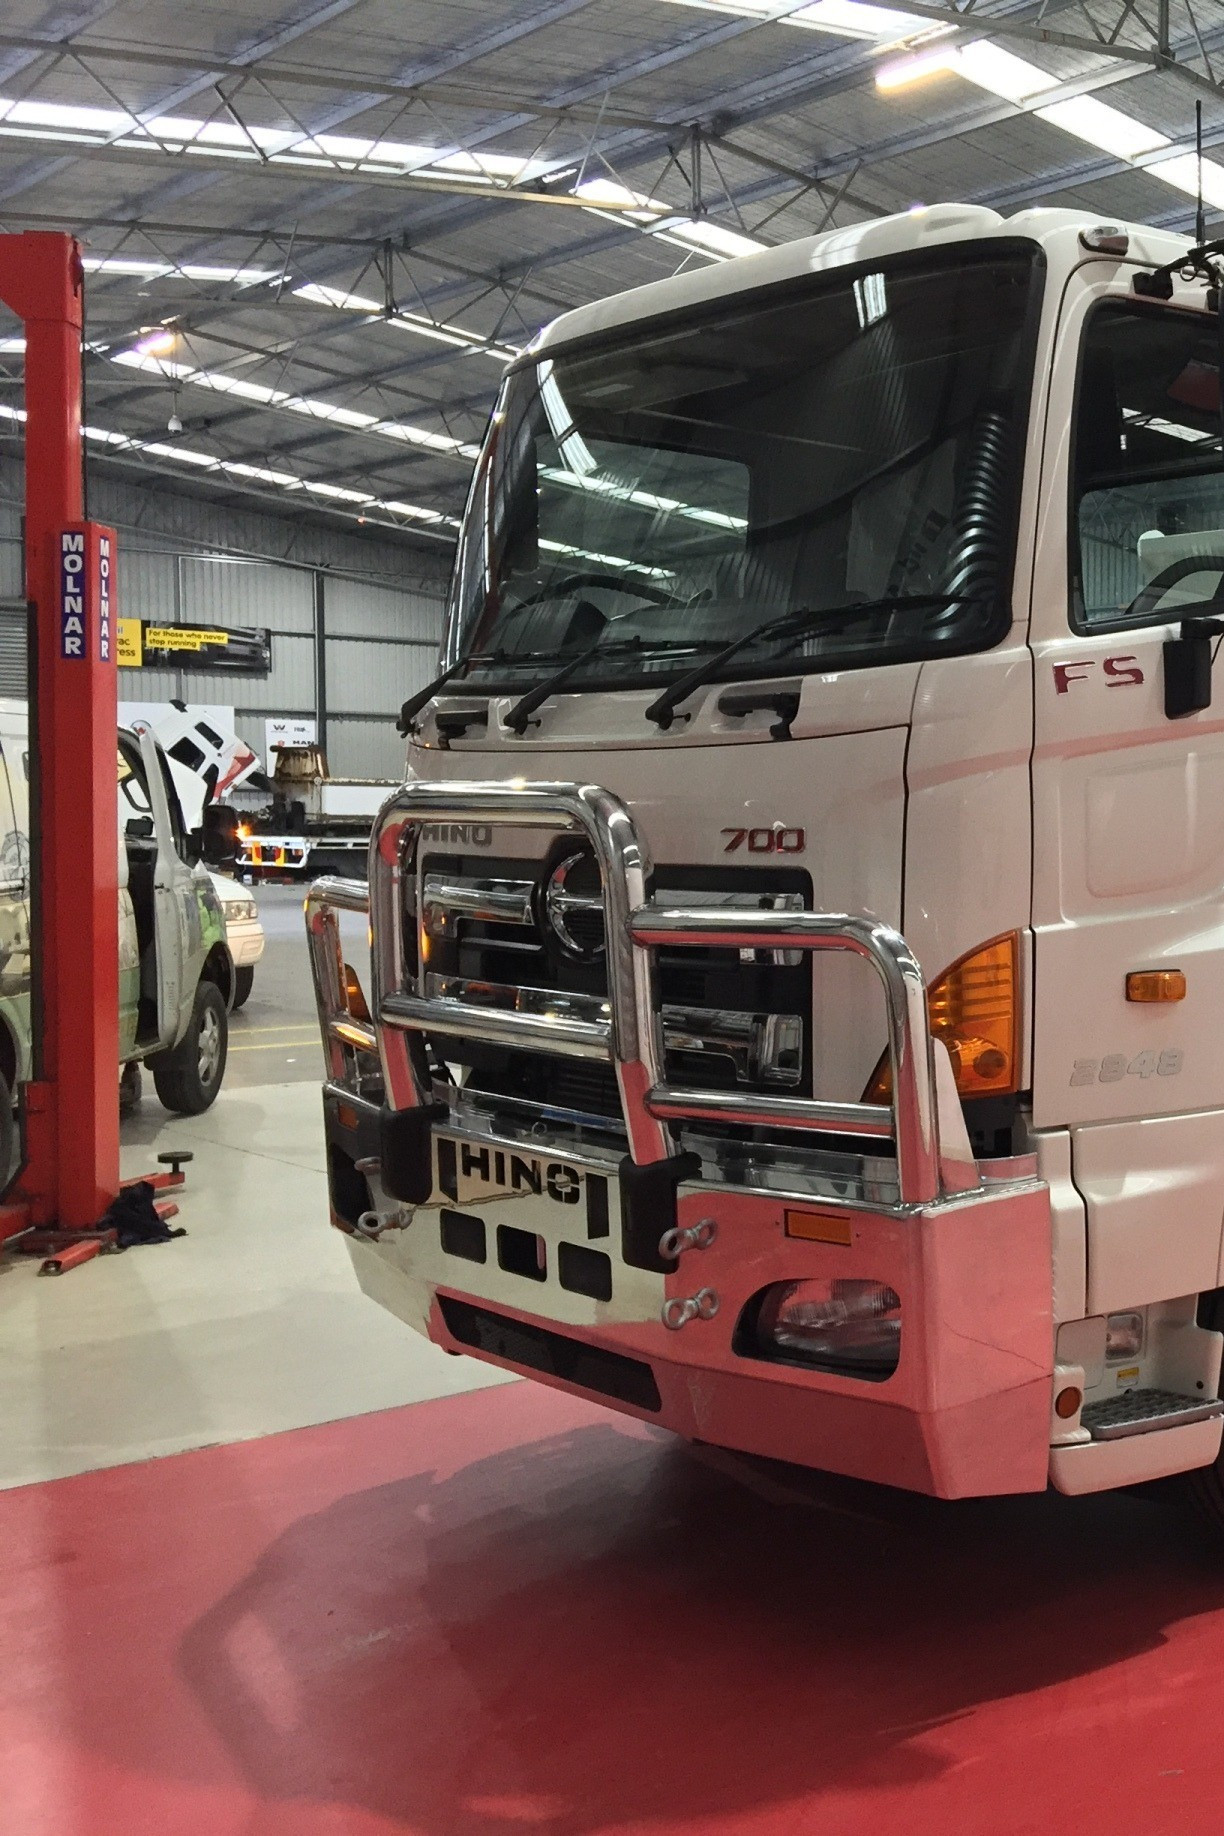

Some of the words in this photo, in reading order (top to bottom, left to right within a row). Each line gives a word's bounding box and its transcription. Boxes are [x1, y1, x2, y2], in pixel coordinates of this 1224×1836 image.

[62, 534, 84, 655] MOLNAR
[100, 538, 110, 658] MOLNAR
[149, 629, 161, 637] For
[163, 630, 184, 638] those
[149, 638, 165, 646] stop
[167, 639, 197, 648] running
[422, 824, 493, 848] HINO
[720, 827, 806, 854] 700
[1068, 1049, 1185, 1087] 2848
[461, 1143, 581, 1205] HINO
